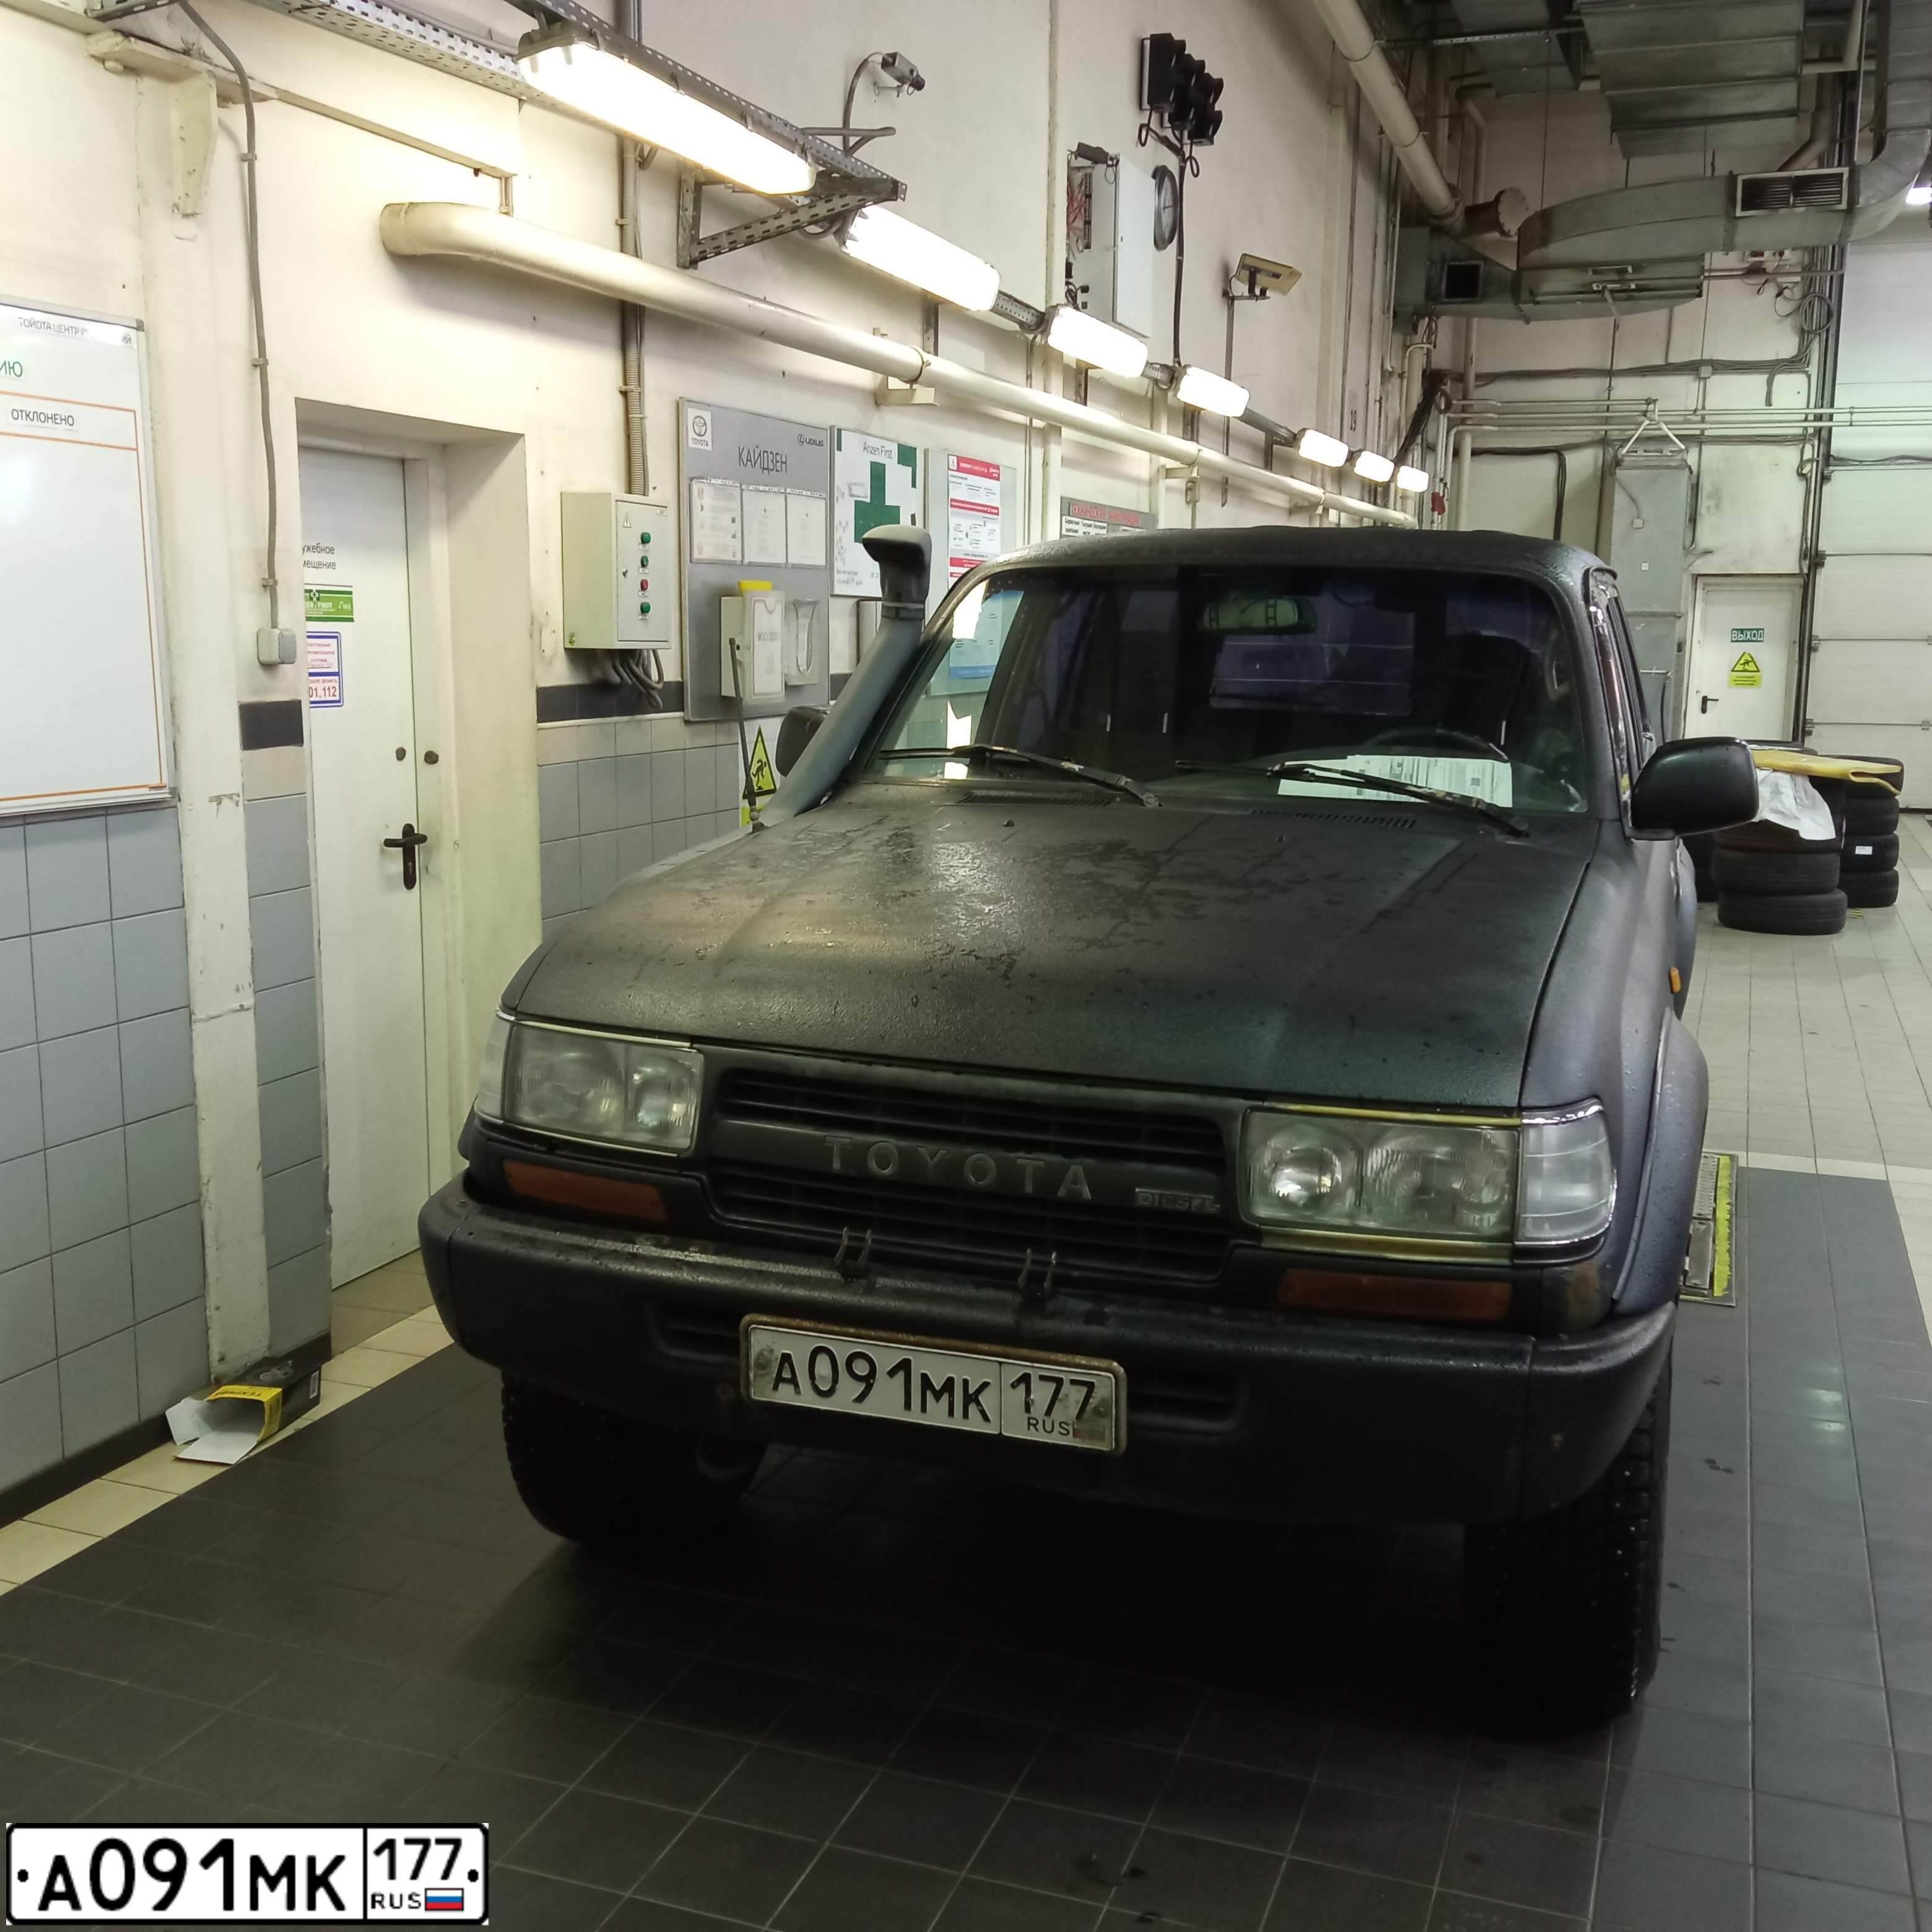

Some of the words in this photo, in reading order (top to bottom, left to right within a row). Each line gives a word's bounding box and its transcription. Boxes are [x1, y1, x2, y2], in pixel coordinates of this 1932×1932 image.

[11, 409, 75, 426] ОТКЛОНЕНО
[692, 437, 709, 446] TOYOTA
[805, 438, 824, 447] LEXUS
[863, 442, 880, 456] Anzen
[881, 446, 893, 459] First
[738, 445, 788, 475] КАЙДЗЕН
[1732, 630, 1764, 641] ВЫХОД
[824, 1134, 1092, 1200] TOYOTA
[1010, 1371, 1096, 1421] 177
[1027, 1416, 1071, 1437] RUS
